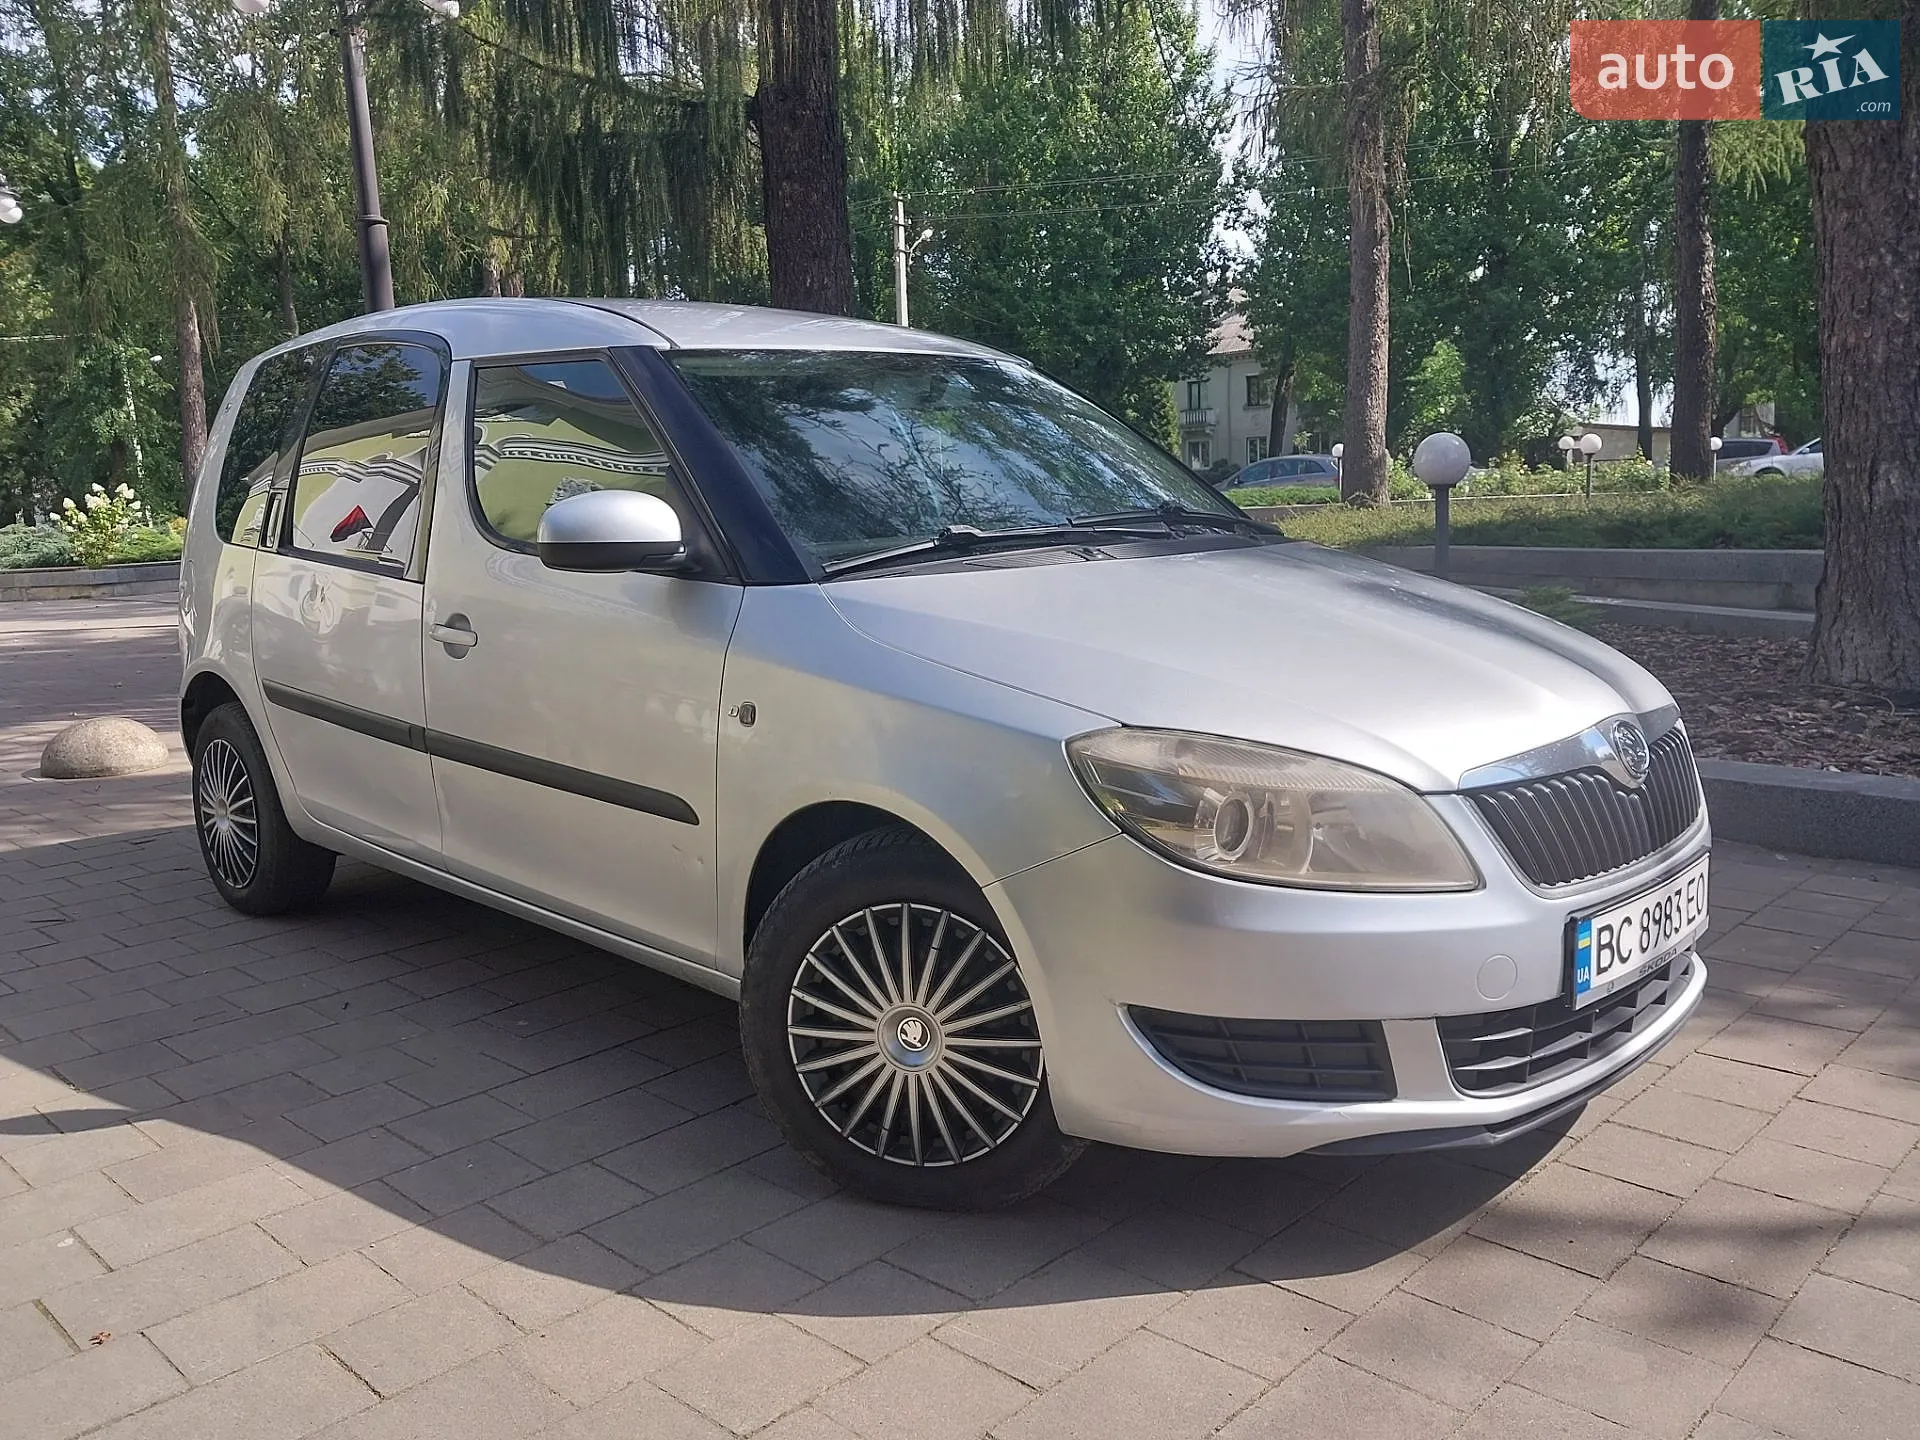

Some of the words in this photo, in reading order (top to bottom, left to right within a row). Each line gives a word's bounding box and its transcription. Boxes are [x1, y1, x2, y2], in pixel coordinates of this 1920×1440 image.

[1596, 916, 1633, 976] BC
[1639, 888, 1682, 954] 8983
[1687, 872, 1705, 926] EO
[1577, 967, 1590, 983] UA
